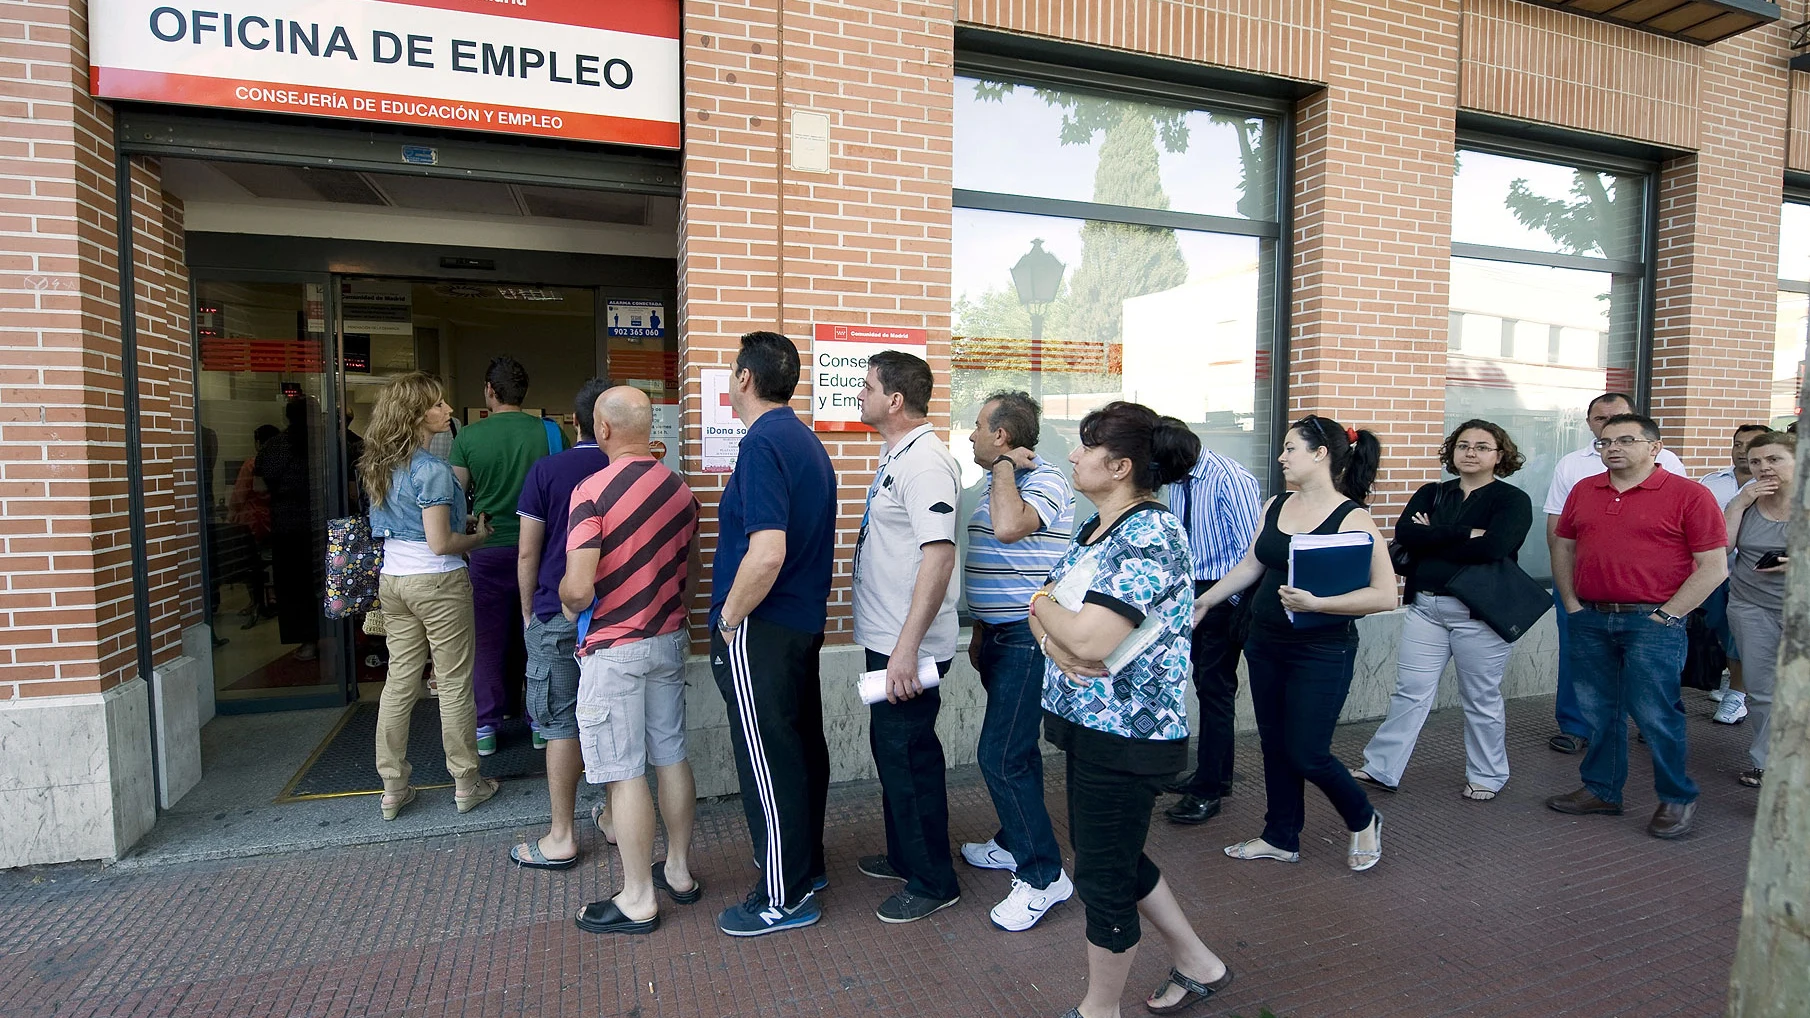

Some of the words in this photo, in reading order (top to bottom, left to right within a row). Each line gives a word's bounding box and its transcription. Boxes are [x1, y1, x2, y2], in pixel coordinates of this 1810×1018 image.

[149, 6, 358, 61] OFICINA
[372, 30, 435, 69] DE
[451, 39, 633, 90] EMPLEO
[235, 86, 349, 110] CONSEJERÍA
[353, 97, 377, 112] DE
[381, 99, 480, 122] EDUCACIÓN
[483, 109, 494, 123] Y
[498, 111, 563, 129] EMPLEO
[819, 396, 827, 410] y
